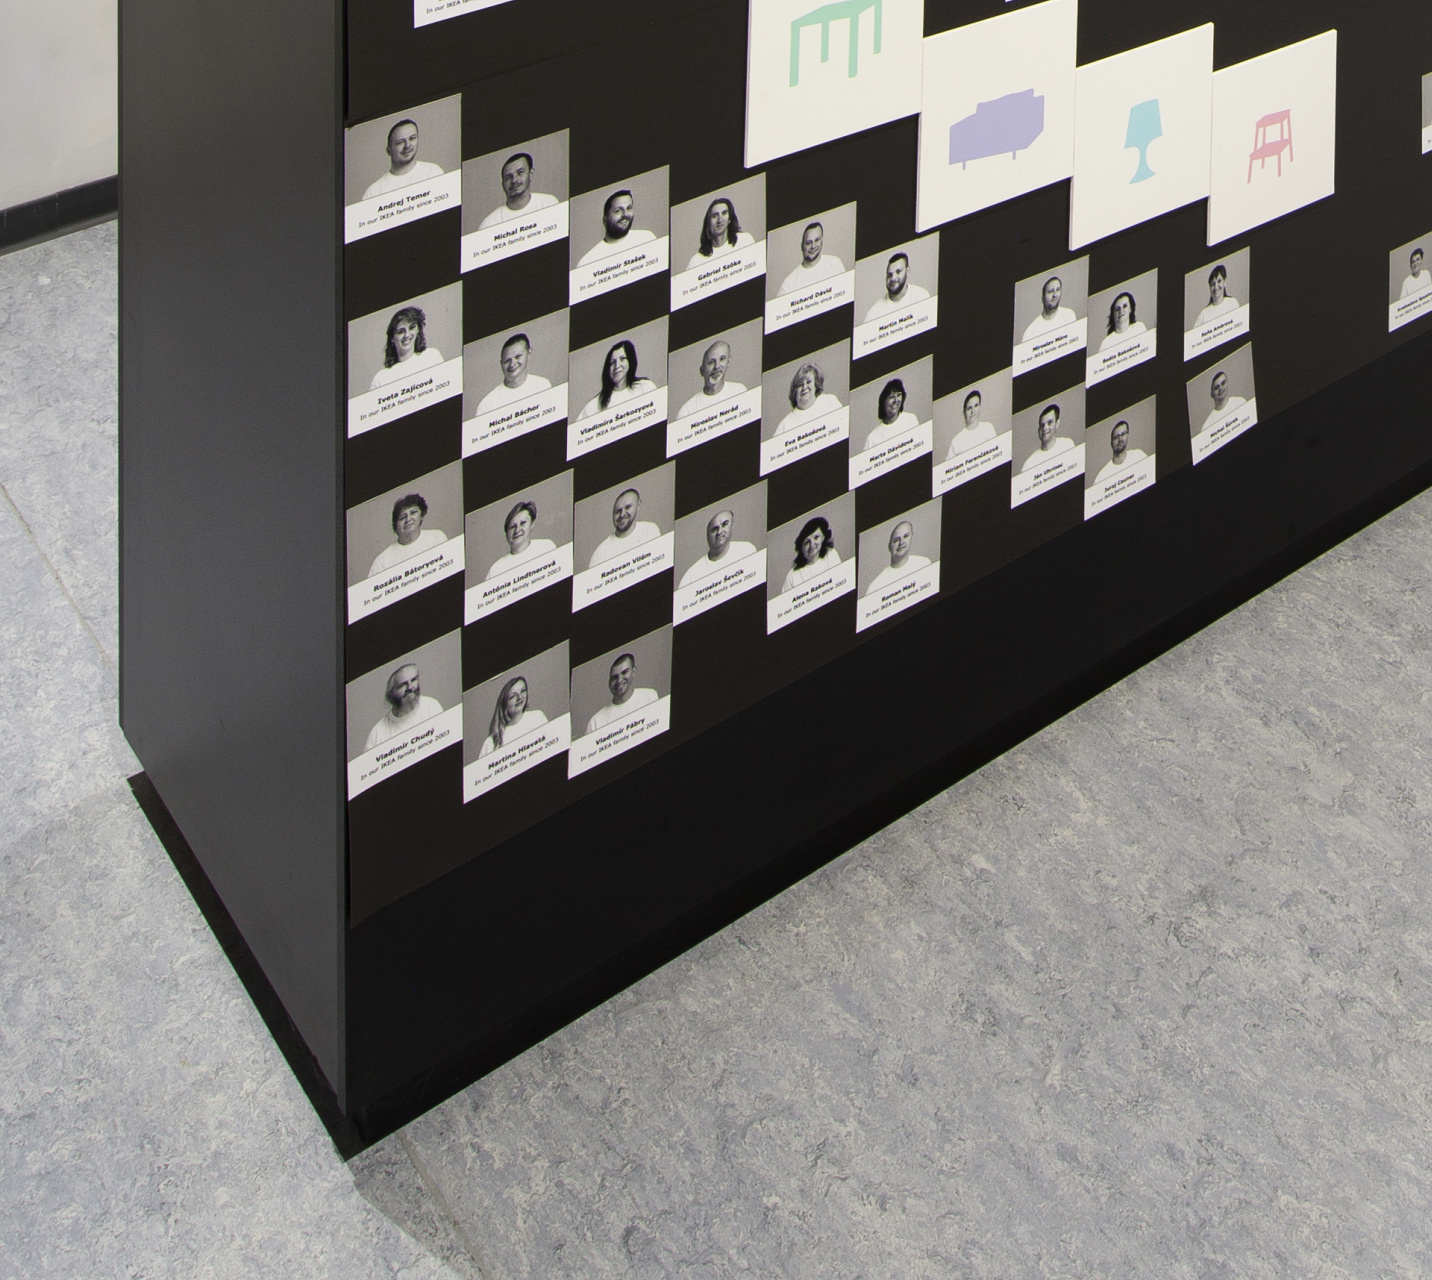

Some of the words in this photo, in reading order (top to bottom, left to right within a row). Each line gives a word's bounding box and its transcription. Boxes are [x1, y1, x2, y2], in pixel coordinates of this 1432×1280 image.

[377, 198, 404, 212] Andrej
[379, 211, 395, 221] IKEA
[396, 205, 415, 215] family
[416, 199, 432, 208] since
[790, 294, 813, 307] Richard
[377, 392, 398, 404] Iveta
[381, 402, 396, 412] IKEA
[397, 395, 416, 405] family
[417, 388, 433, 398] since
[380, 757, 396, 769] IKEA
[397, 747, 416, 760] family
[417, 738, 433, 750] since
